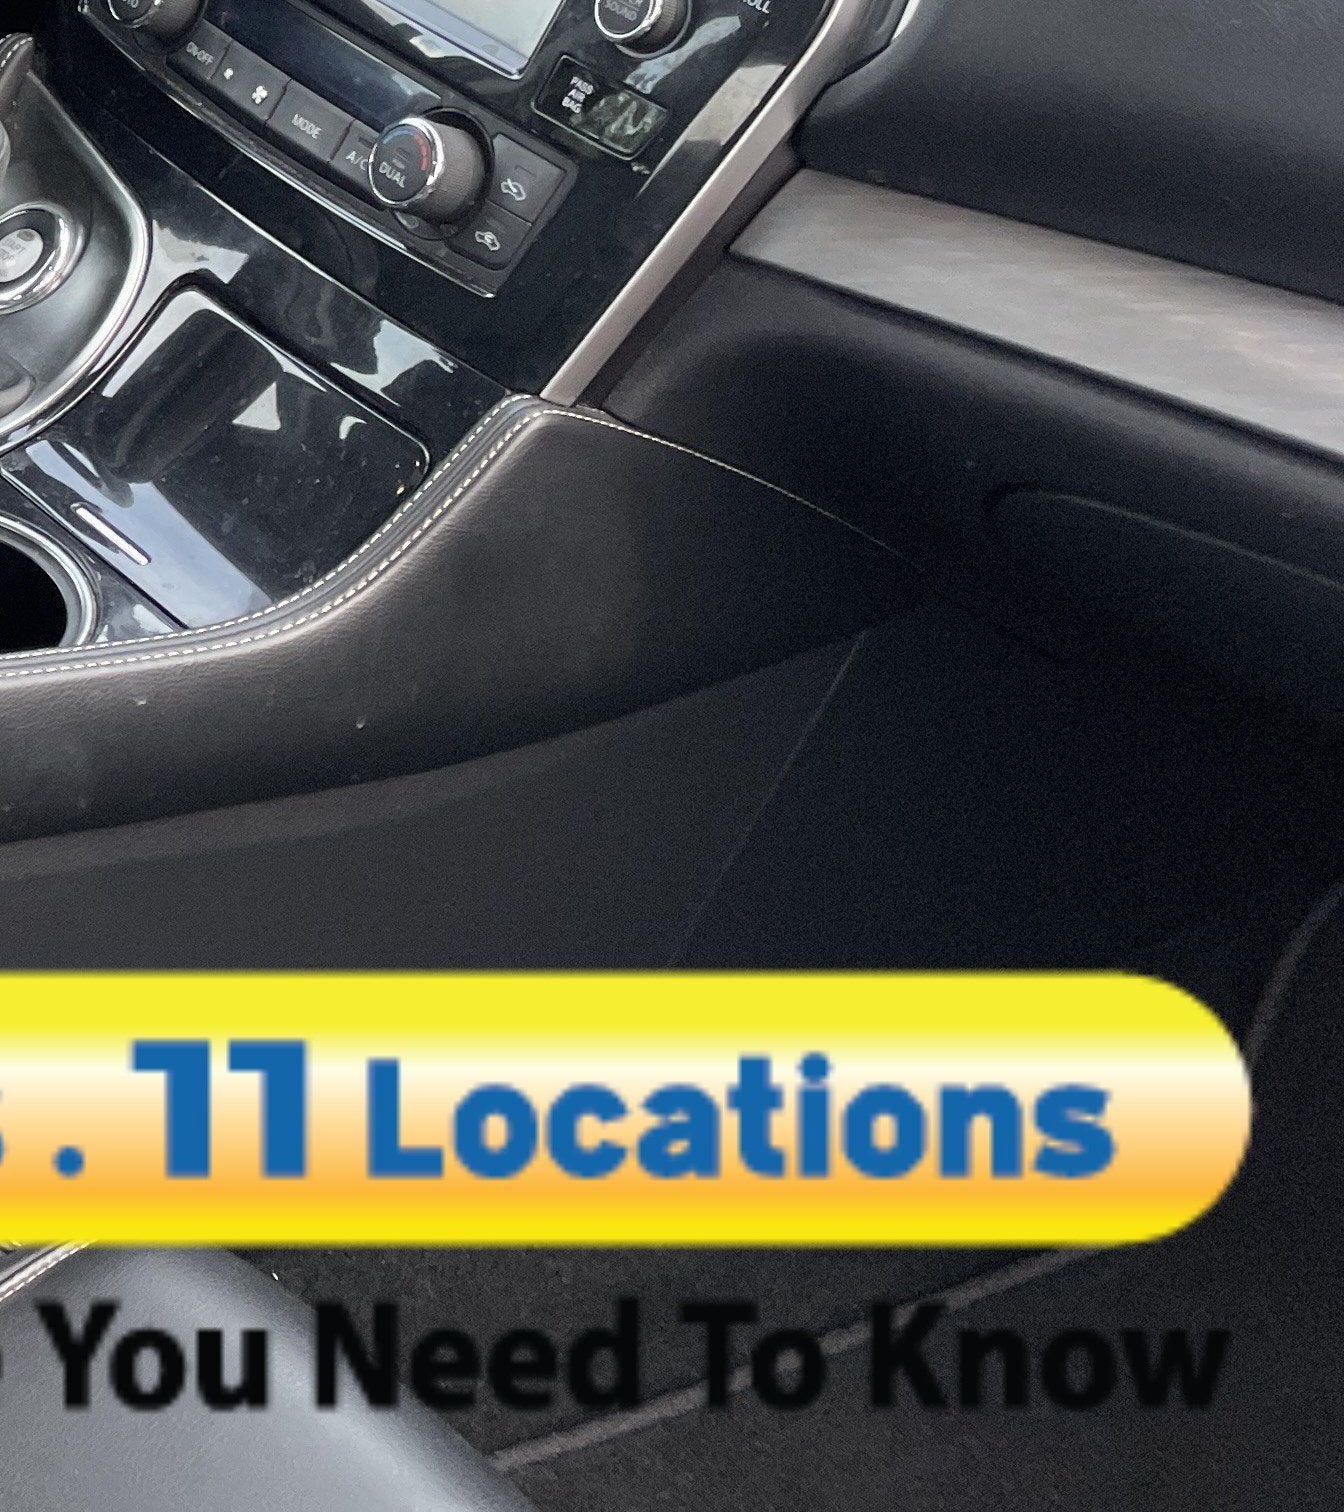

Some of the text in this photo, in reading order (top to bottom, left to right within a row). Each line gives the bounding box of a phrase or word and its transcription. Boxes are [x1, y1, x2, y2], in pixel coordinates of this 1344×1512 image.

[291, 113, 322, 139] MODE
[345, 150, 369, 171] A/C
[378, 161, 406, 188] DUAL
